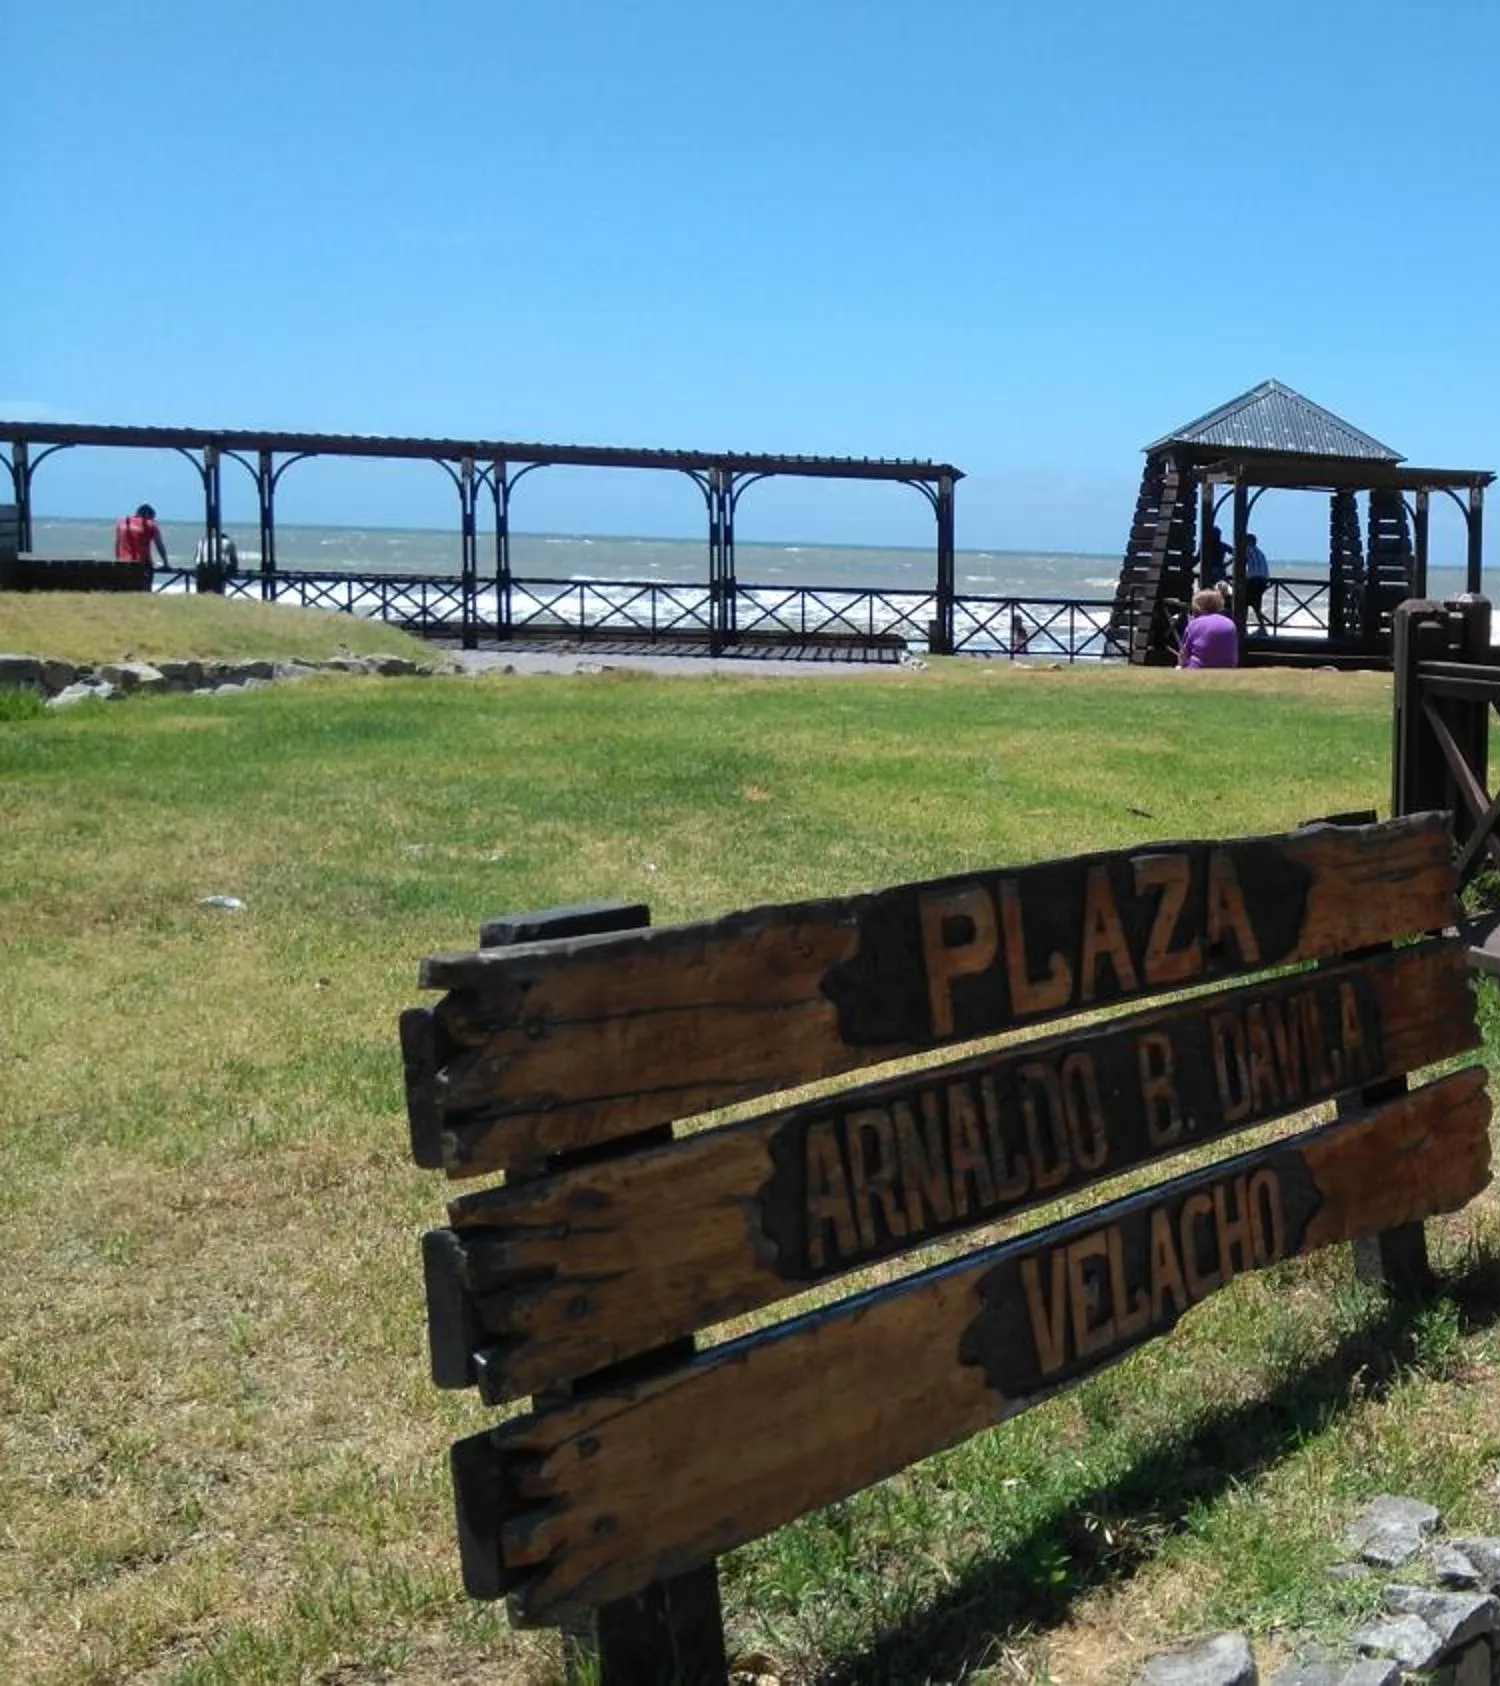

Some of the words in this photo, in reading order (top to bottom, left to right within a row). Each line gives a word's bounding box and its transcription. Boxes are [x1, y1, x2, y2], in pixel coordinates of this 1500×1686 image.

[919, 850, 1261, 1037] PLAZA
[804, 1052, 1108, 1267] ARNALDO
[1138, 1033, 1196, 1147] B.
[1210, 982, 1367, 1121] DAVILA
[1020, 1169, 1285, 1376] VELACHO
